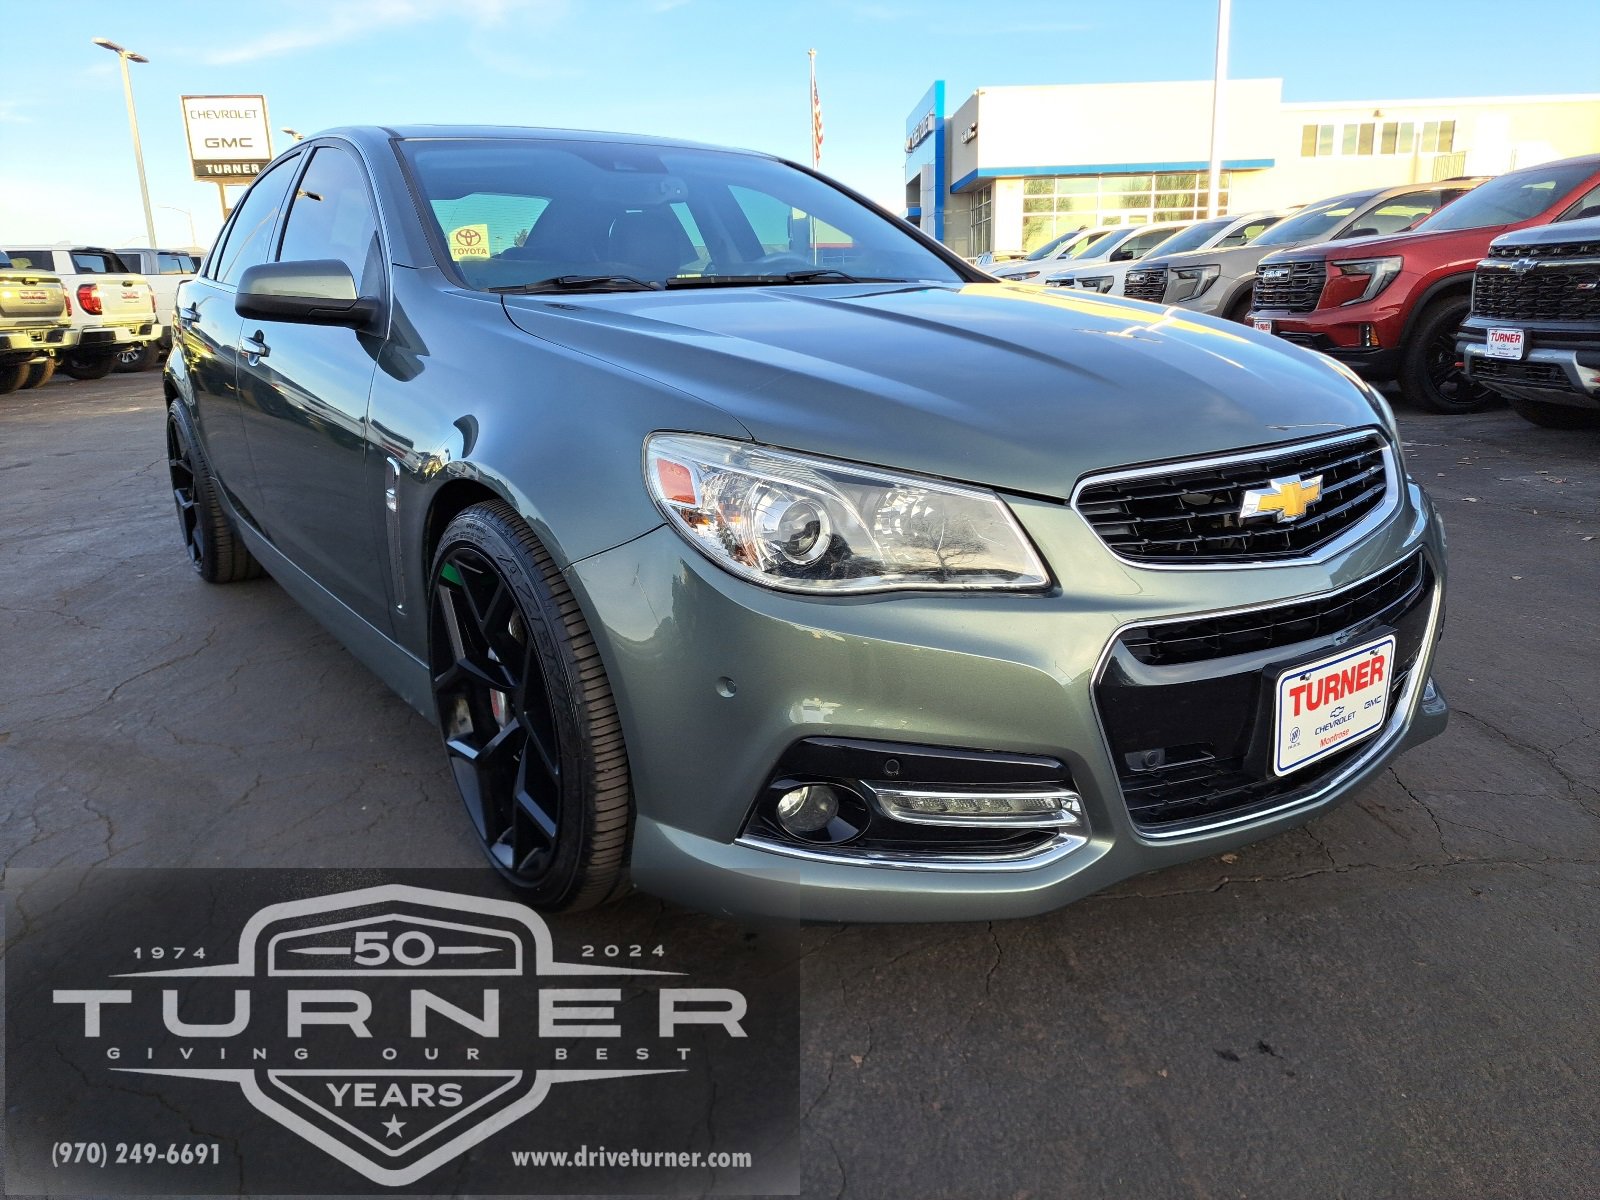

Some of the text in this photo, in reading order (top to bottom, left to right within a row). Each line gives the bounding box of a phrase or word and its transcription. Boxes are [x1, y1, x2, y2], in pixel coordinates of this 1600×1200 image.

[190, 109, 258, 120] CHEVROLET
[204, 138, 253, 148] GMC
[205, 163, 260, 174] TURNER
[1491, 332, 1521, 343] TURNER
[1289, 654, 1385, 717] TURNER
[1363, 695, 1382, 710] GMC
[1314, 711, 1356, 736] CHEVROLET
[1319, 728, 1350, 748] Montrose
